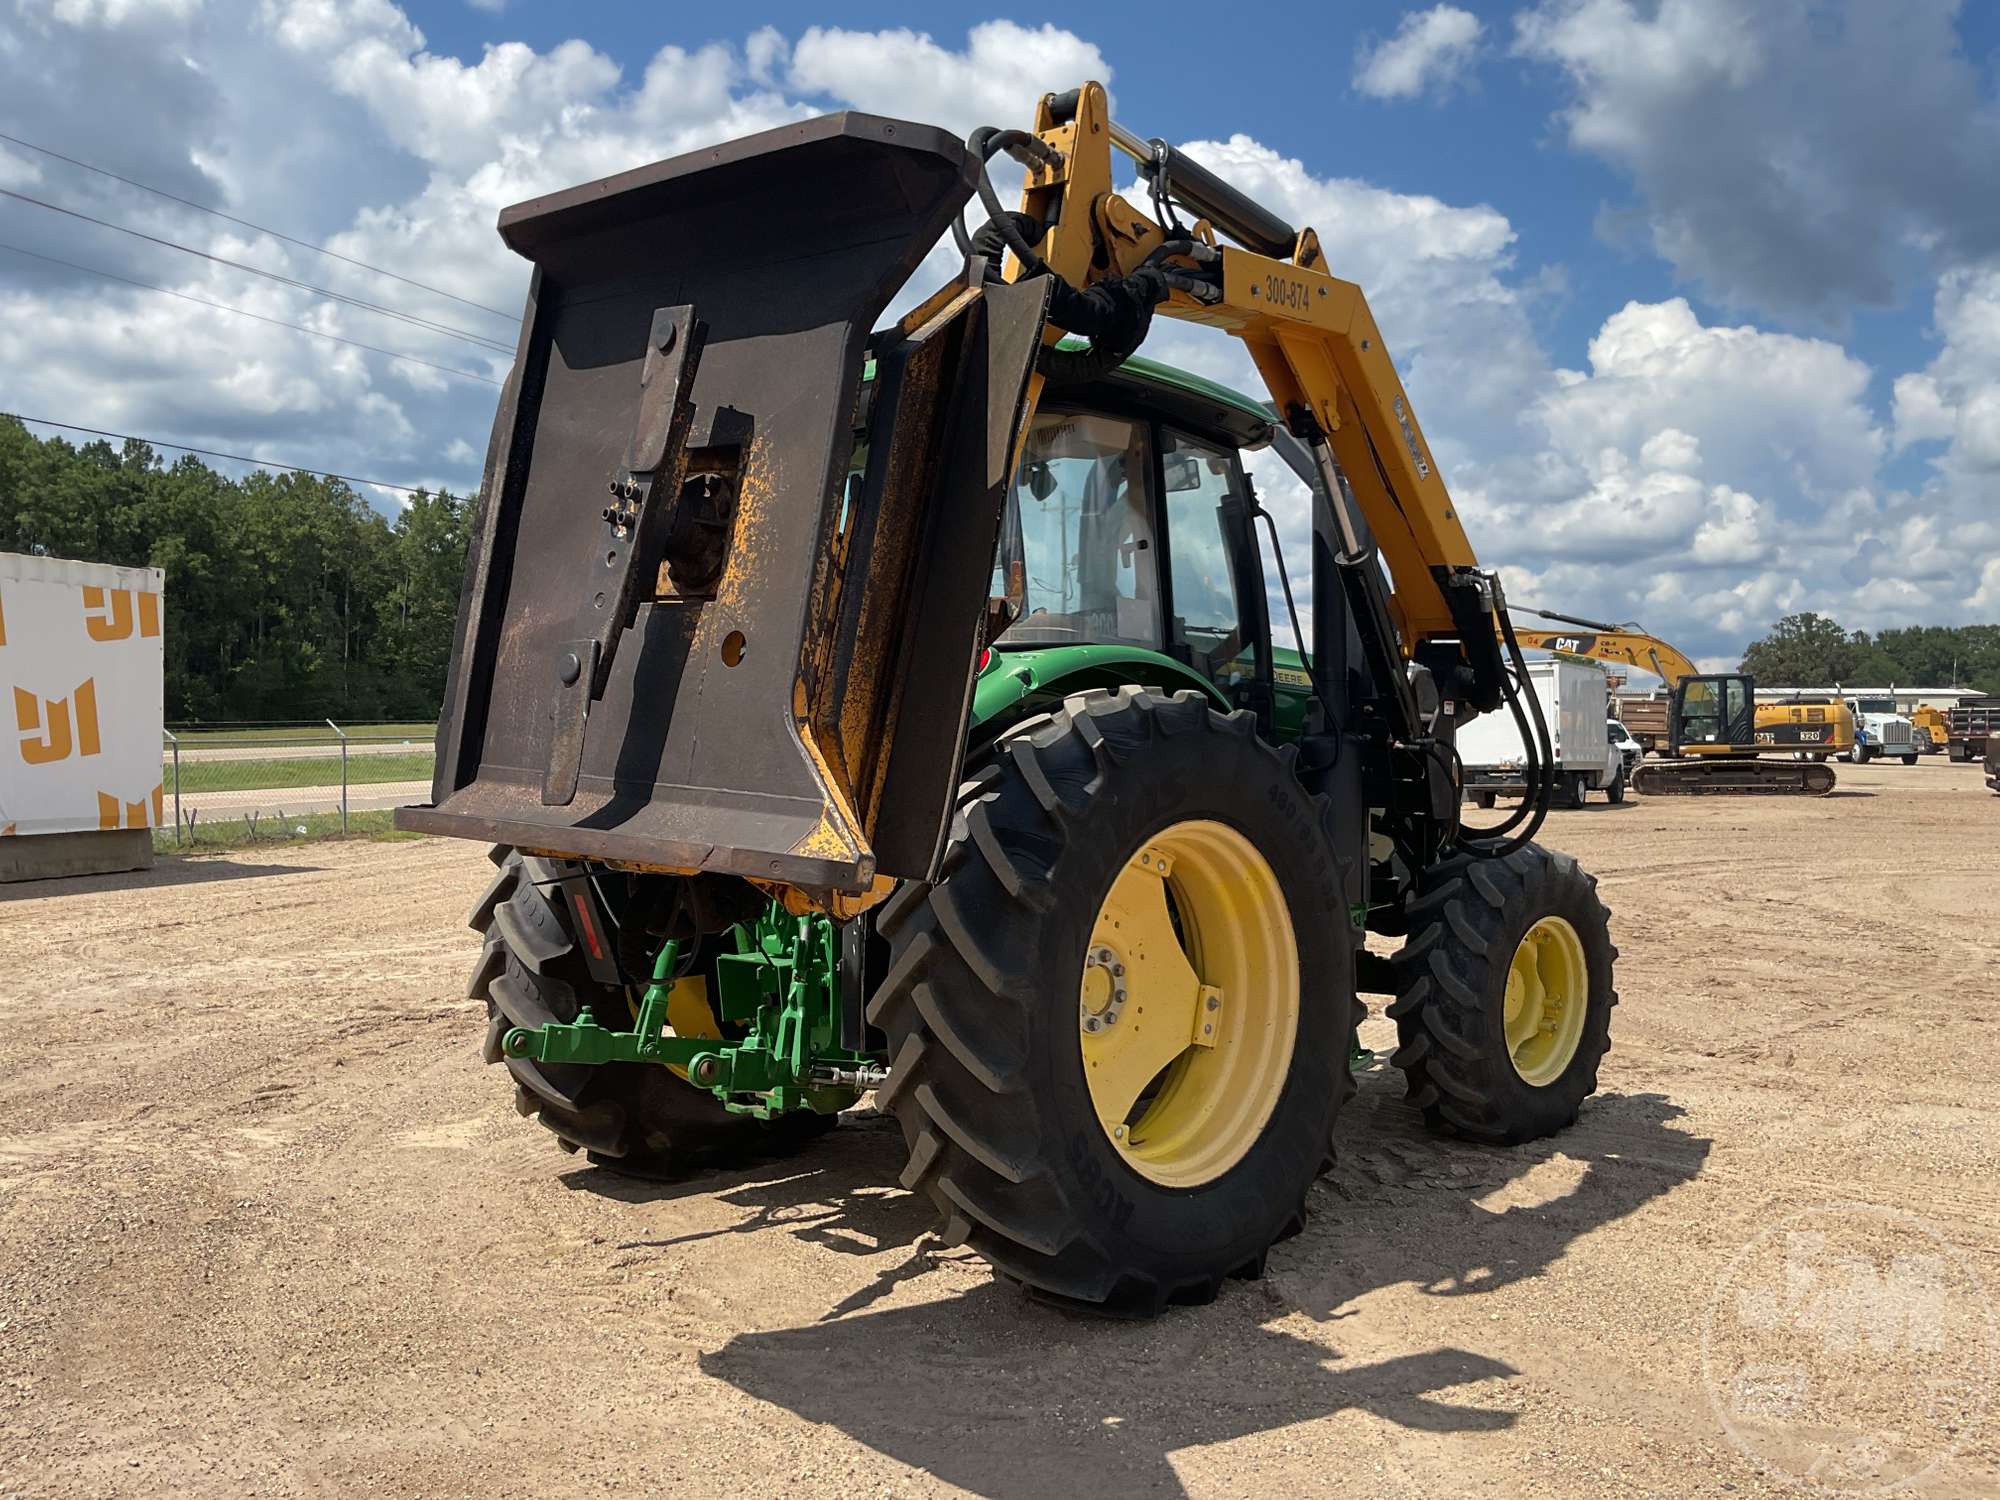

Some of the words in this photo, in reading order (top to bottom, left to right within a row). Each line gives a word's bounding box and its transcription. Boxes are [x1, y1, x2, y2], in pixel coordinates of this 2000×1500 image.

[1266, 274, 1309, 312] 300-874
[1555, 637, 1580, 653] CAT
[1754, 732, 1775, 745] CAT
[1800, 731, 1820, 741] 320
